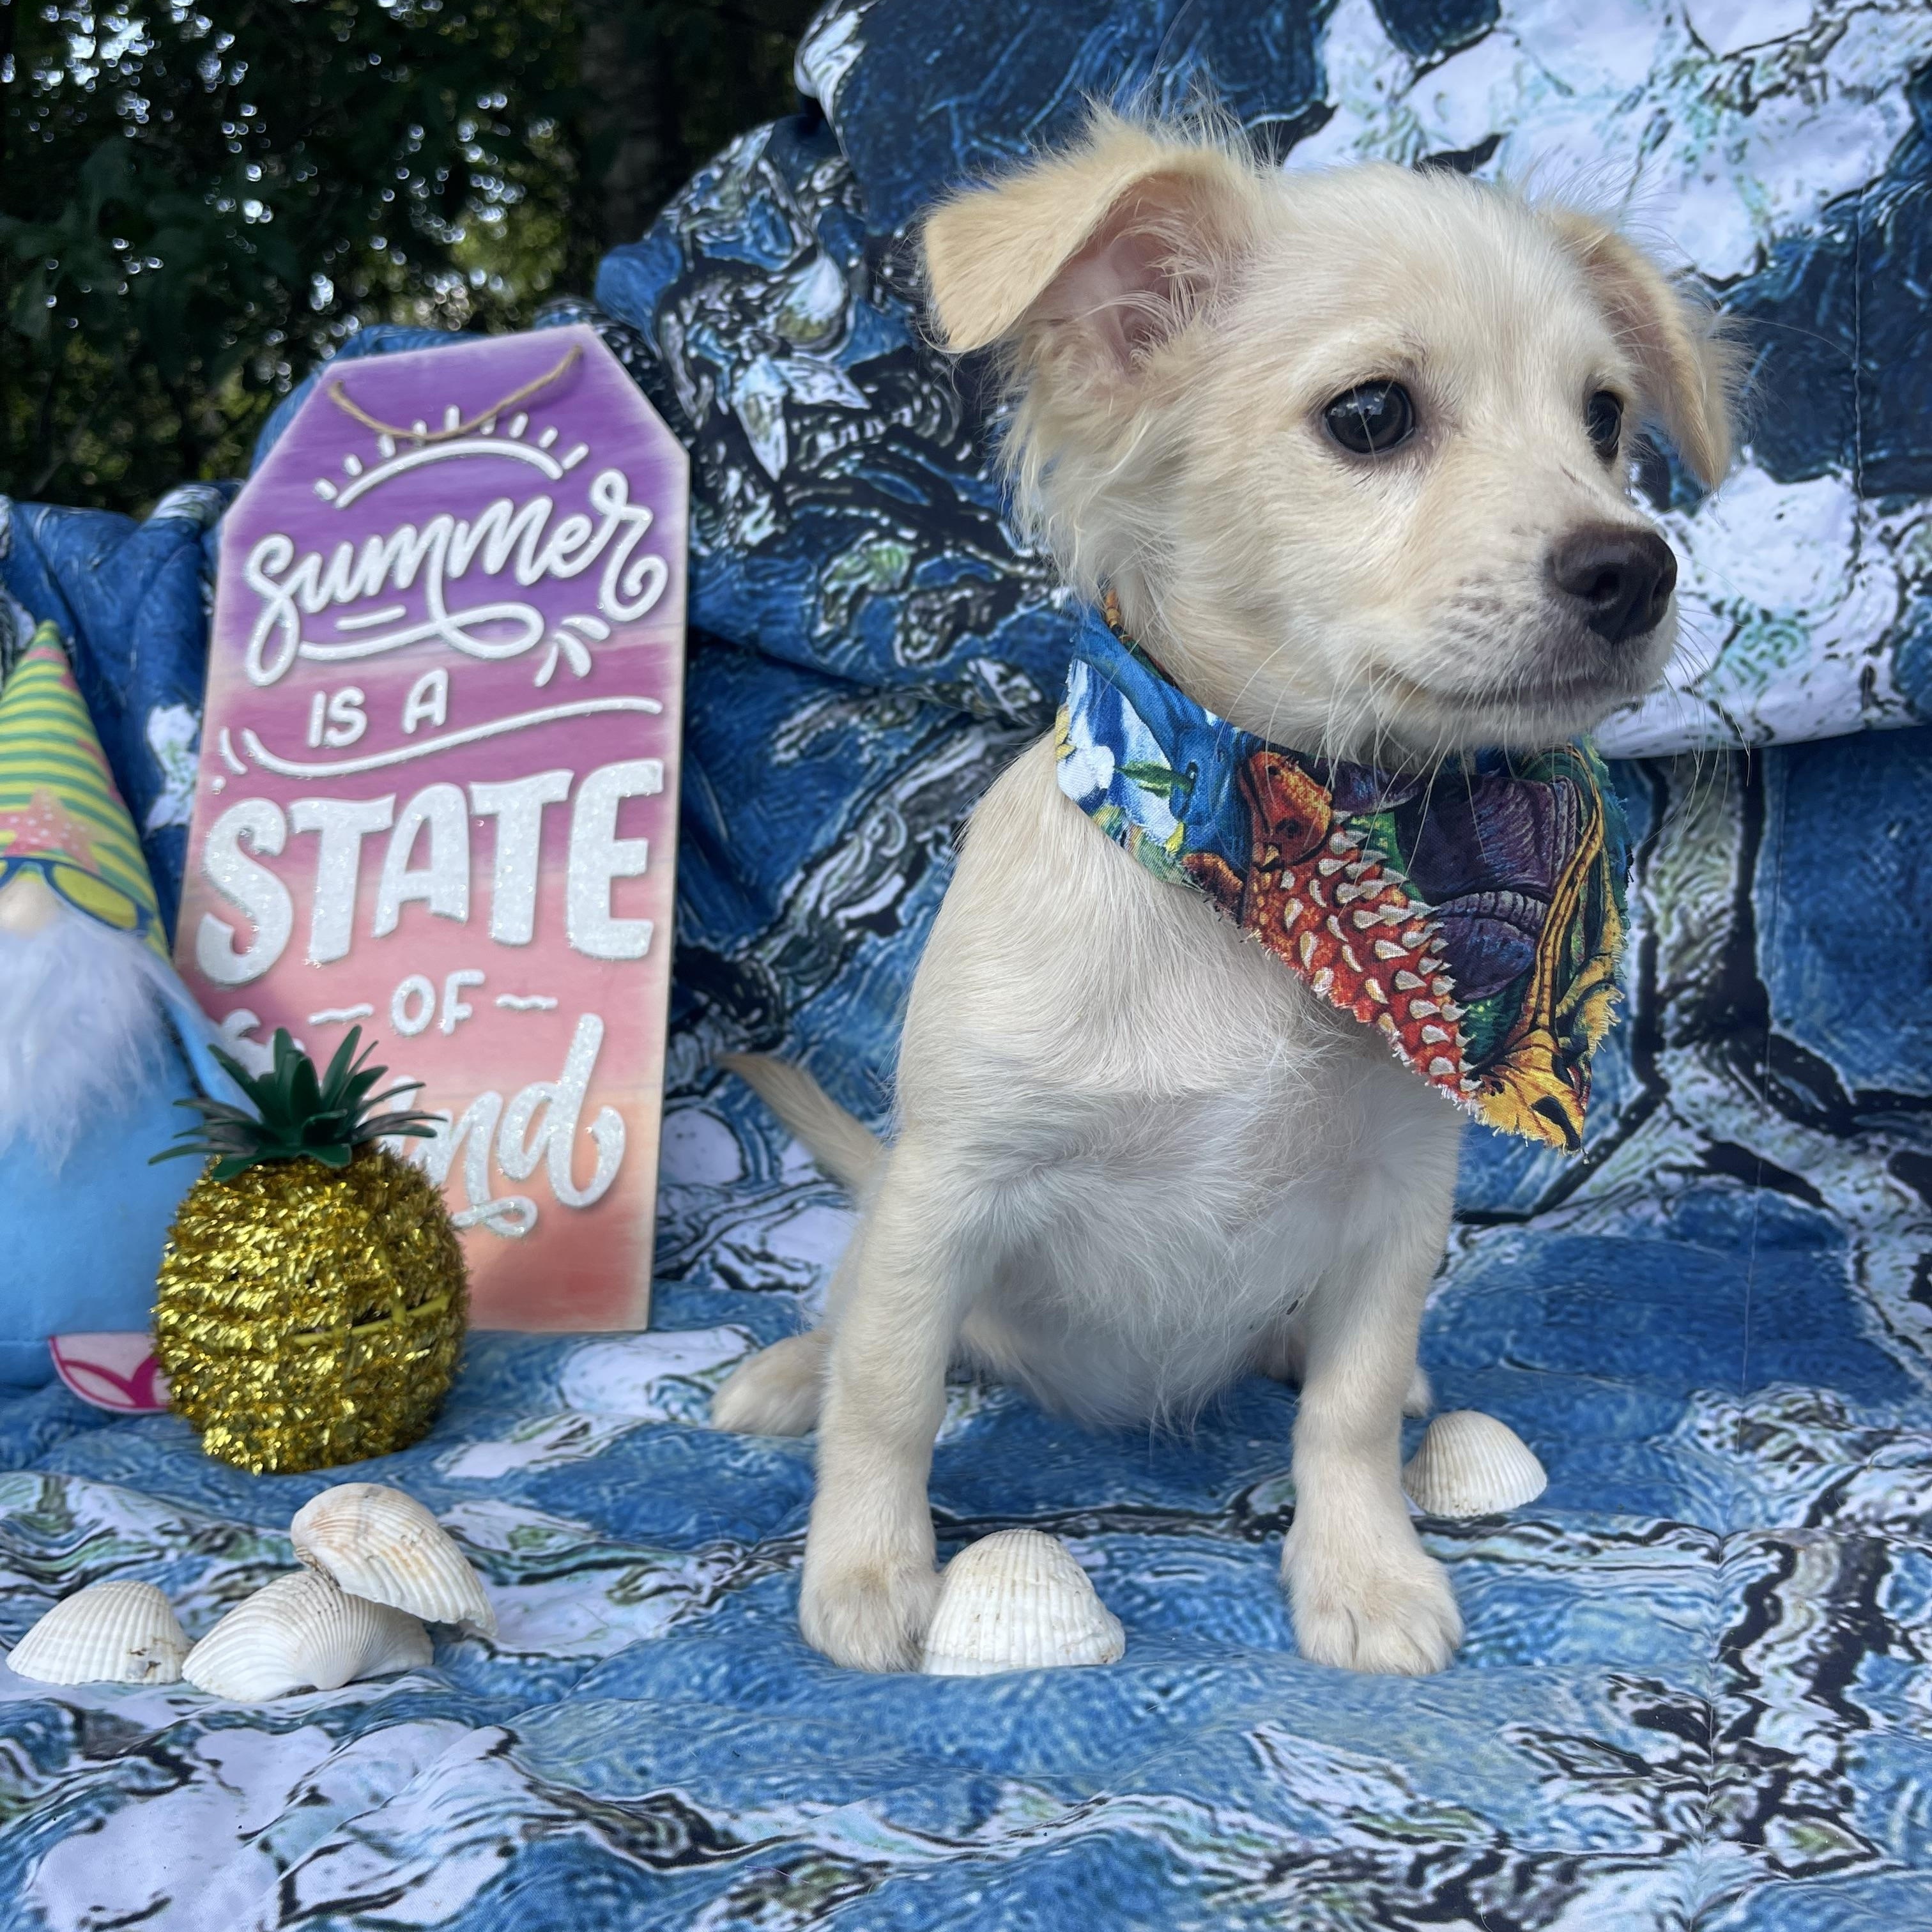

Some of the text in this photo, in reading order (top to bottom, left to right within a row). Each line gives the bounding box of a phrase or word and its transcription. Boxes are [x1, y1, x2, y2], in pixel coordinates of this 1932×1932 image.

[307, 668, 448, 749] IS A
[195, 759, 664, 986] STATE
[390, 969, 486, 1036] OF
[220, 1008, 626, 1238] nd
